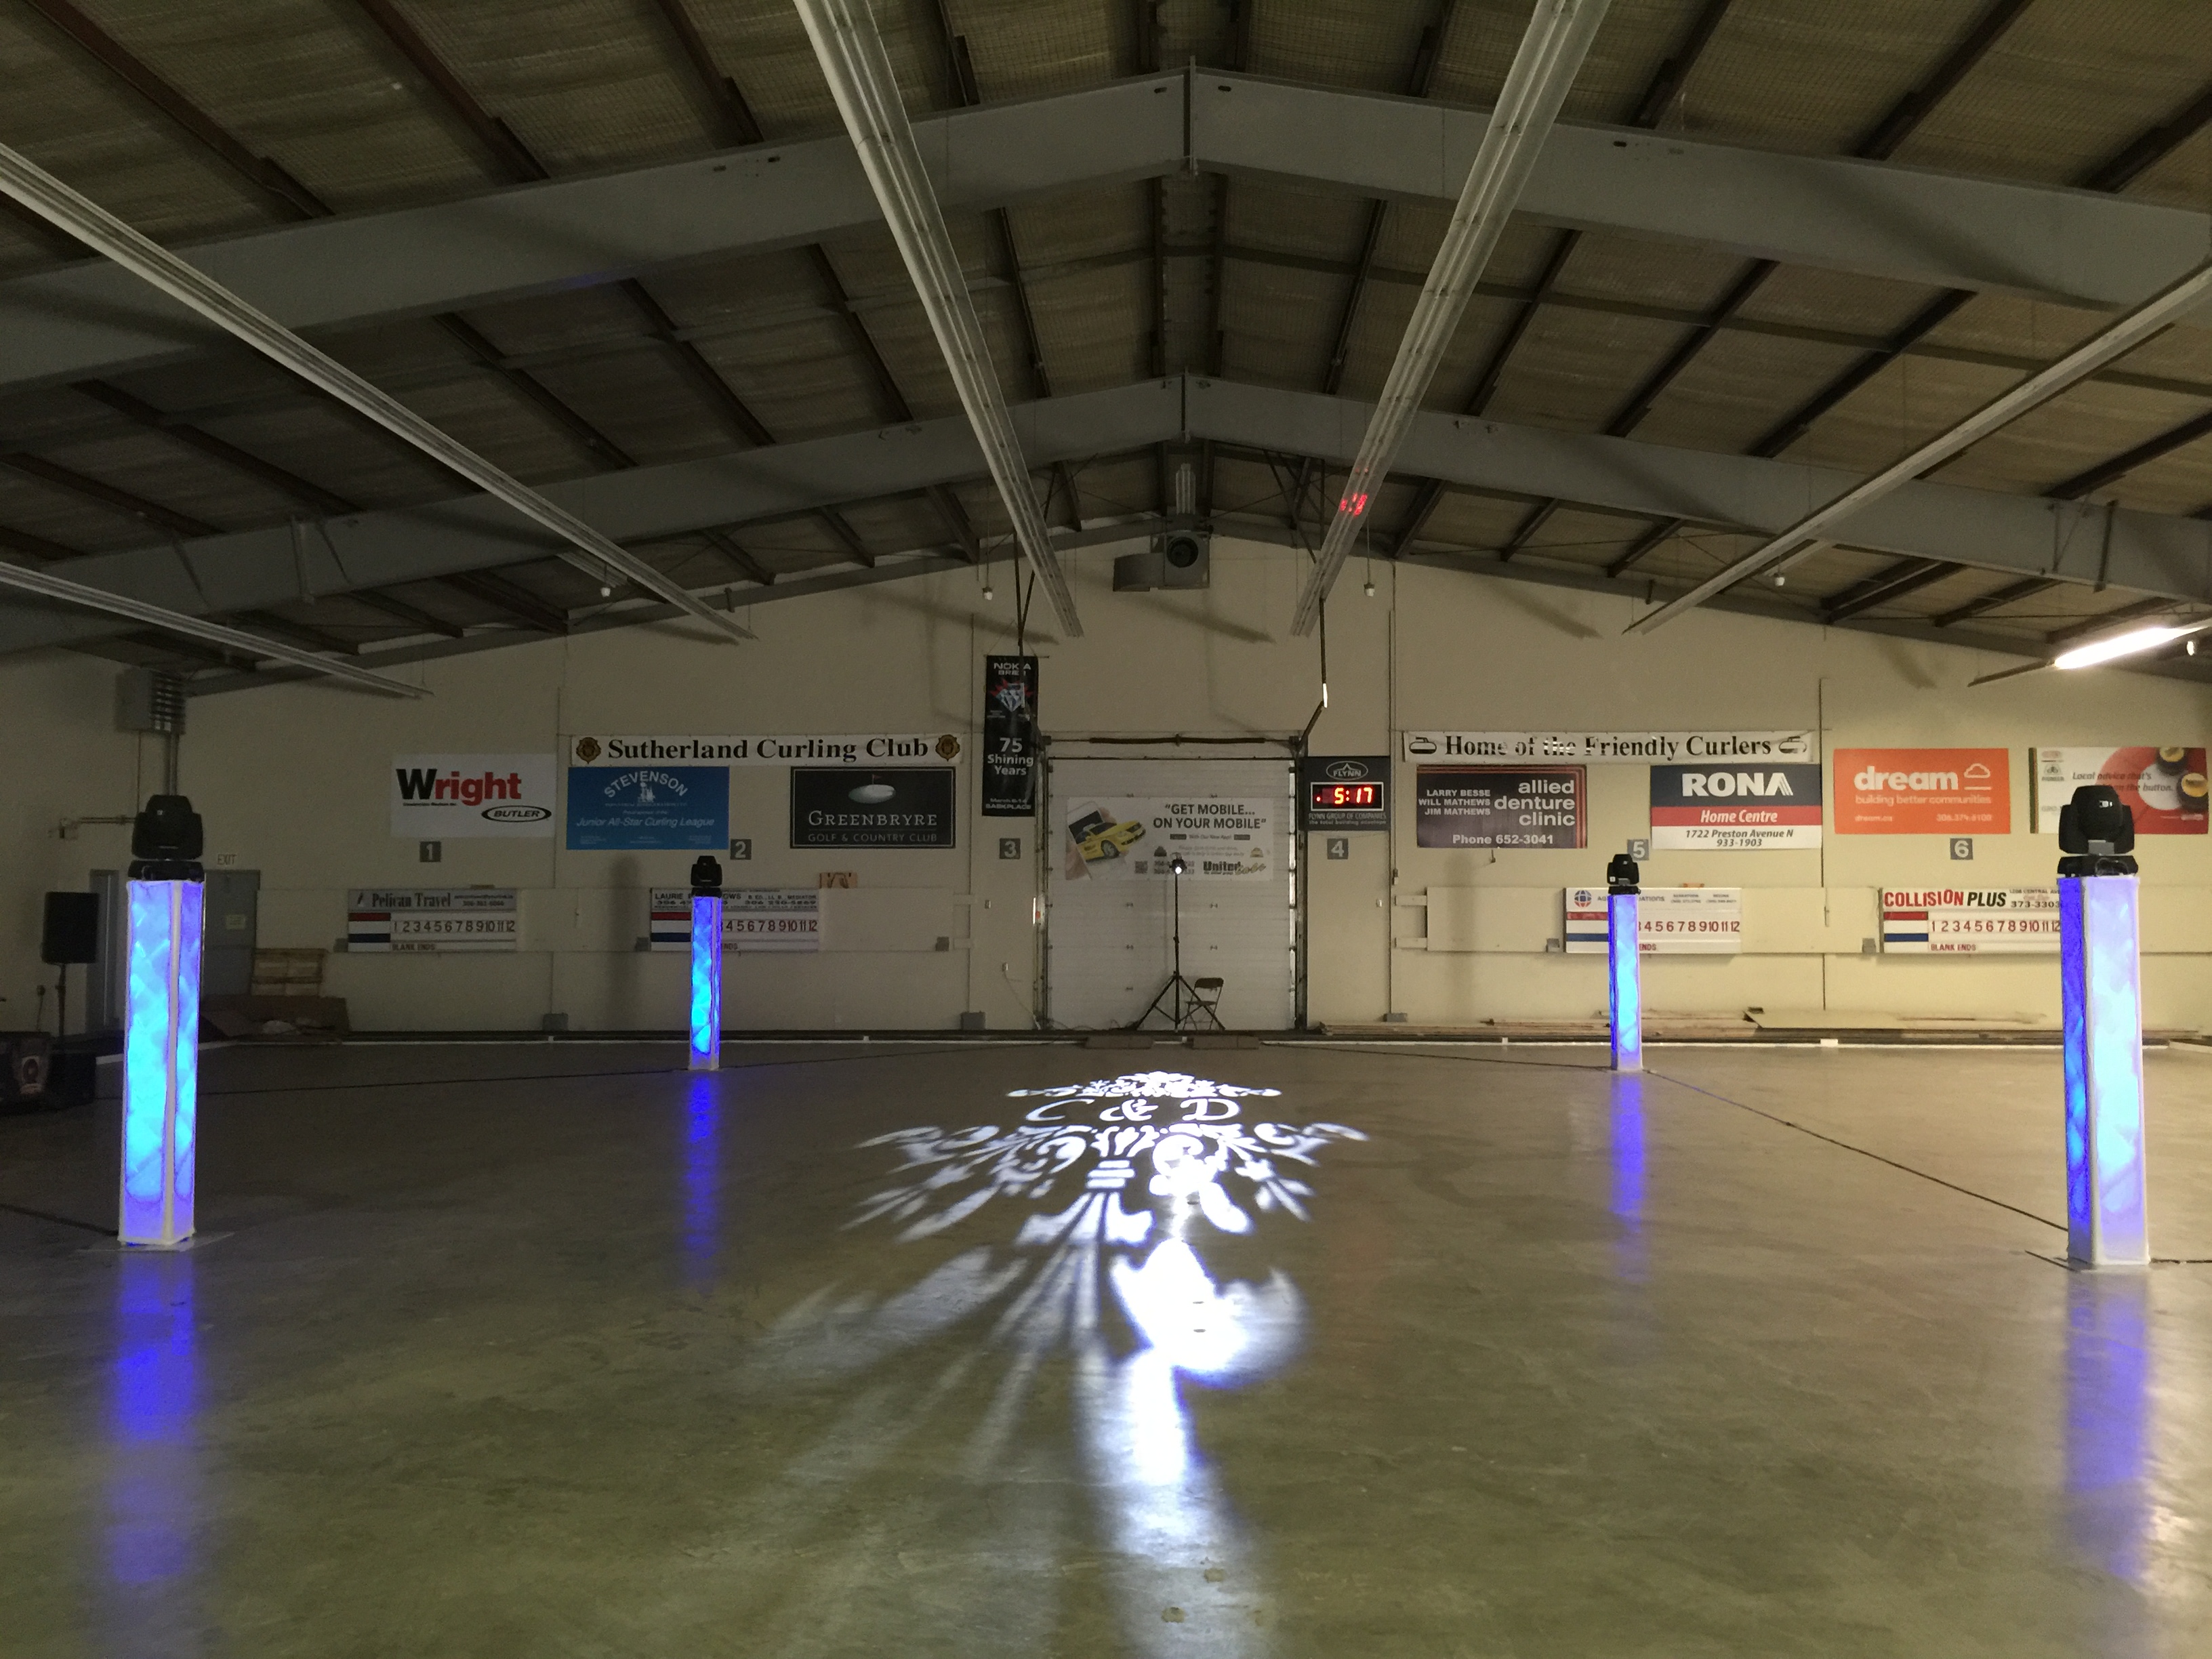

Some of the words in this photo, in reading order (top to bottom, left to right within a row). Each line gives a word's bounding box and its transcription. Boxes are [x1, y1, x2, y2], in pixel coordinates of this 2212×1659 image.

[607, 739, 748, 759] Sutherland
[757, 739, 857, 762] Curling
[866, 737, 928, 758] Club
[1000, 737, 1023, 752] 75
[1445, 736, 1508, 756] Home
[1515, 737, 1538, 756] of
[1543, 736, 1576, 756] the
[1584, 736, 1677, 760] Friendly
[1685, 735, 1771, 756] Curlers
[987, 754, 1034, 766] Shining
[994, 765, 1027, 775] Years
[604, 771, 689, 798] STEVENSON
[1681, 772, 1794, 797] RONA
[1853, 766, 1959, 790] dream
[396, 769, 522, 806] Wright
[1518, 779, 1574, 794] allied
[1334, 787, 1373, 804] 5:17
[1494, 796, 1575, 809] denture
[1855, 794, 1894, 806] building
[1896, 795, 1926, 804] better
[1930, 794, 1991, 804] communities
[1197, 804, 1255, 815] MOBILE...
[1700, 810, 1736, 823] Home
[1738, 810, 1778, 823] Centre
[577, 817, 607, 827] Junior
[608, 817, 643, 826] All-Star
[644, 817, 678, 828] Curling
[680, 818, 715, 828] League
[808, 810, 937, 826] GREENBRYRE
[1153, 818, 1172, 828] ON
[1175, 818, 1210, 828] YOUR
[1519, 812, 1576, 826] clinic
[808, 834, 836, 842] GOLF
[842, 834, 848, 842] &
[853, 834, 905, 842] COUNTRY
[909, 834, 937, 842] CLUB
[1452, 834, 1492, 844] Phone
[1496, 834, 1553, 844] 652-3041
[1685, 830, 1709, 838] 1722
[1711, 830, 1748, 838] Preston
[1749, 830, 1782, 838] Avenue
[1786, 830, 1794, 838] N
[735, 841, 745, 858] 2
[1004, 840, 1017, 857] 3
[1331, 840, 1344, 857] 4
[1633, 841, 1645, 858] 5
[1717, 838, 1762, 847] 933-1903
[1954, 840, 1969, 857] 6
[426, 844, 433, 860] 1
[218, 854, 237, 865] EXIT
[372, 893, 411, 907] Pelican
[414, 893, 451, 907] Travel
[1884, 889, 1964, 907] COLLISION
[1967, 892, 2007, 907] PLUS
[394, 920, 397, 932] 1
[403, 920, 409, 932] 2
[413, 920, 421, 932] 3
[424, 920, 431, 932] 4
[434, 920, 442, 932] 5
[445, 920, 452, 932] 6
[455, 920, 462, 932] 7
[466, 920, 473, 932] 8
[476, 920, 483, 932] 9
[485, 920, 495, 932] 10
[497, 920, 504, 932] 11
[506, 920, 515, 932] 12
[726, 920, 733, 931] 4
[737, 920, 744, 931] 5
[747, 920, 755, 931] 6
[758, 920, 766, 931] 7
[768, 920, 776, 931] 8
[779, 920, 786, 931] 9
[788, 920, 797, 931] 10
[800, 920, 806, 931] 11
[809, 920, 817, 931] 12
[1644, 921, 1652, 932] 4
[1656, 921, 1663, 932] 5
[1666, 921, 1674, 932] 6
[1677, 921, 1685, 932] 7
[1688, 921, 1696, 932] 8
[1699, 921, 1707, 932] 9
[1708, 921, 1719, 932] 10
[1721, 921, 1728, 932] 11
[1730, 921, 1740, 932] 12
[1931, 921, 1936, 932] 1
[1941, 921, 1949, 932] 2
[1952, 921, 1960, 932] 3
[1963, 921, 1971, 932] 4
[1975, 921, 1982, 932] 5
[1986, 921, 1994, 932] 6
[1998, 921, 2005, 932] 7
[2008, 921, 2016, 932] 8
[2019, 921, 2027, 932] 9
[2029, 921, 2039, 932] 10
[2042, 921, 2049, 932] 11
[2051, 921, 2061, 932] 12
[1180, 1098, 1241, 1121] D
